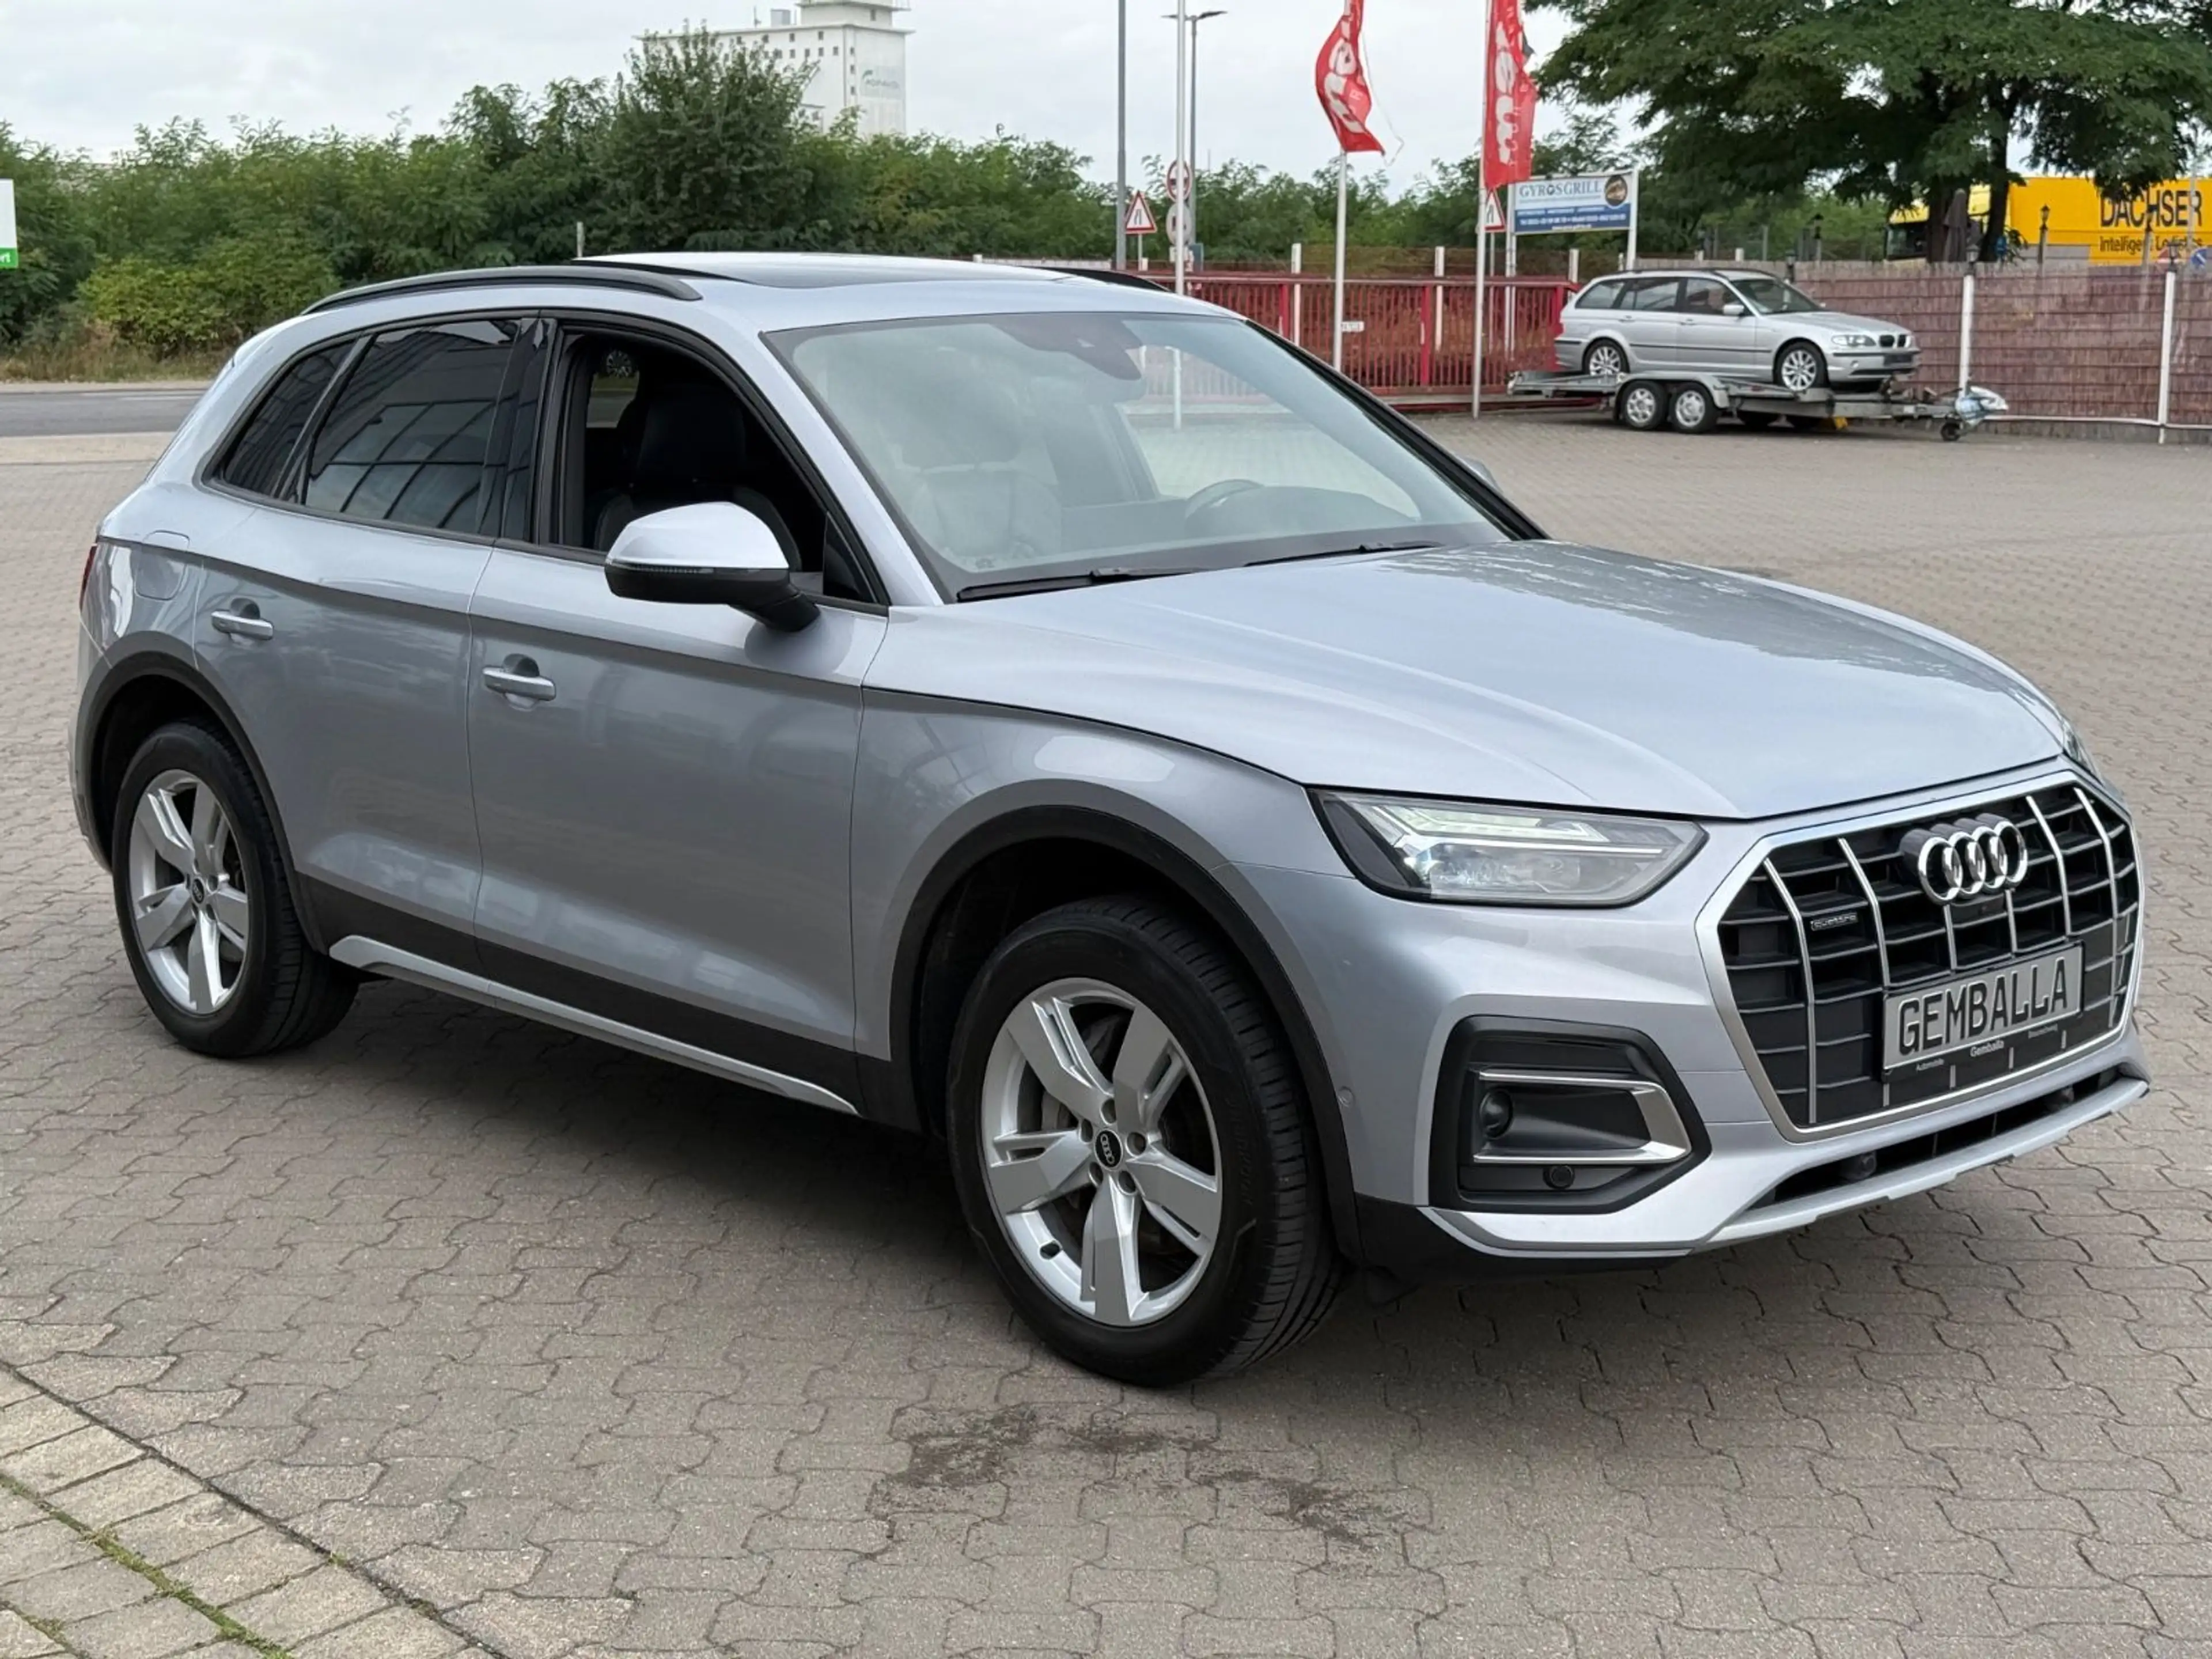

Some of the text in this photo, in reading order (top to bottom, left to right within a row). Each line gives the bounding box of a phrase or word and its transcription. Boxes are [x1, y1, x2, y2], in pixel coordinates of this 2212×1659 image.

[2100, 190, 2202, 227] DACHSER
[2100, 235, 2203, 255] Intellige Loists
[1899, 957, 2068, 1055] GEMBALLA
[1970, 1039, 2005, 1057] Gemballa
